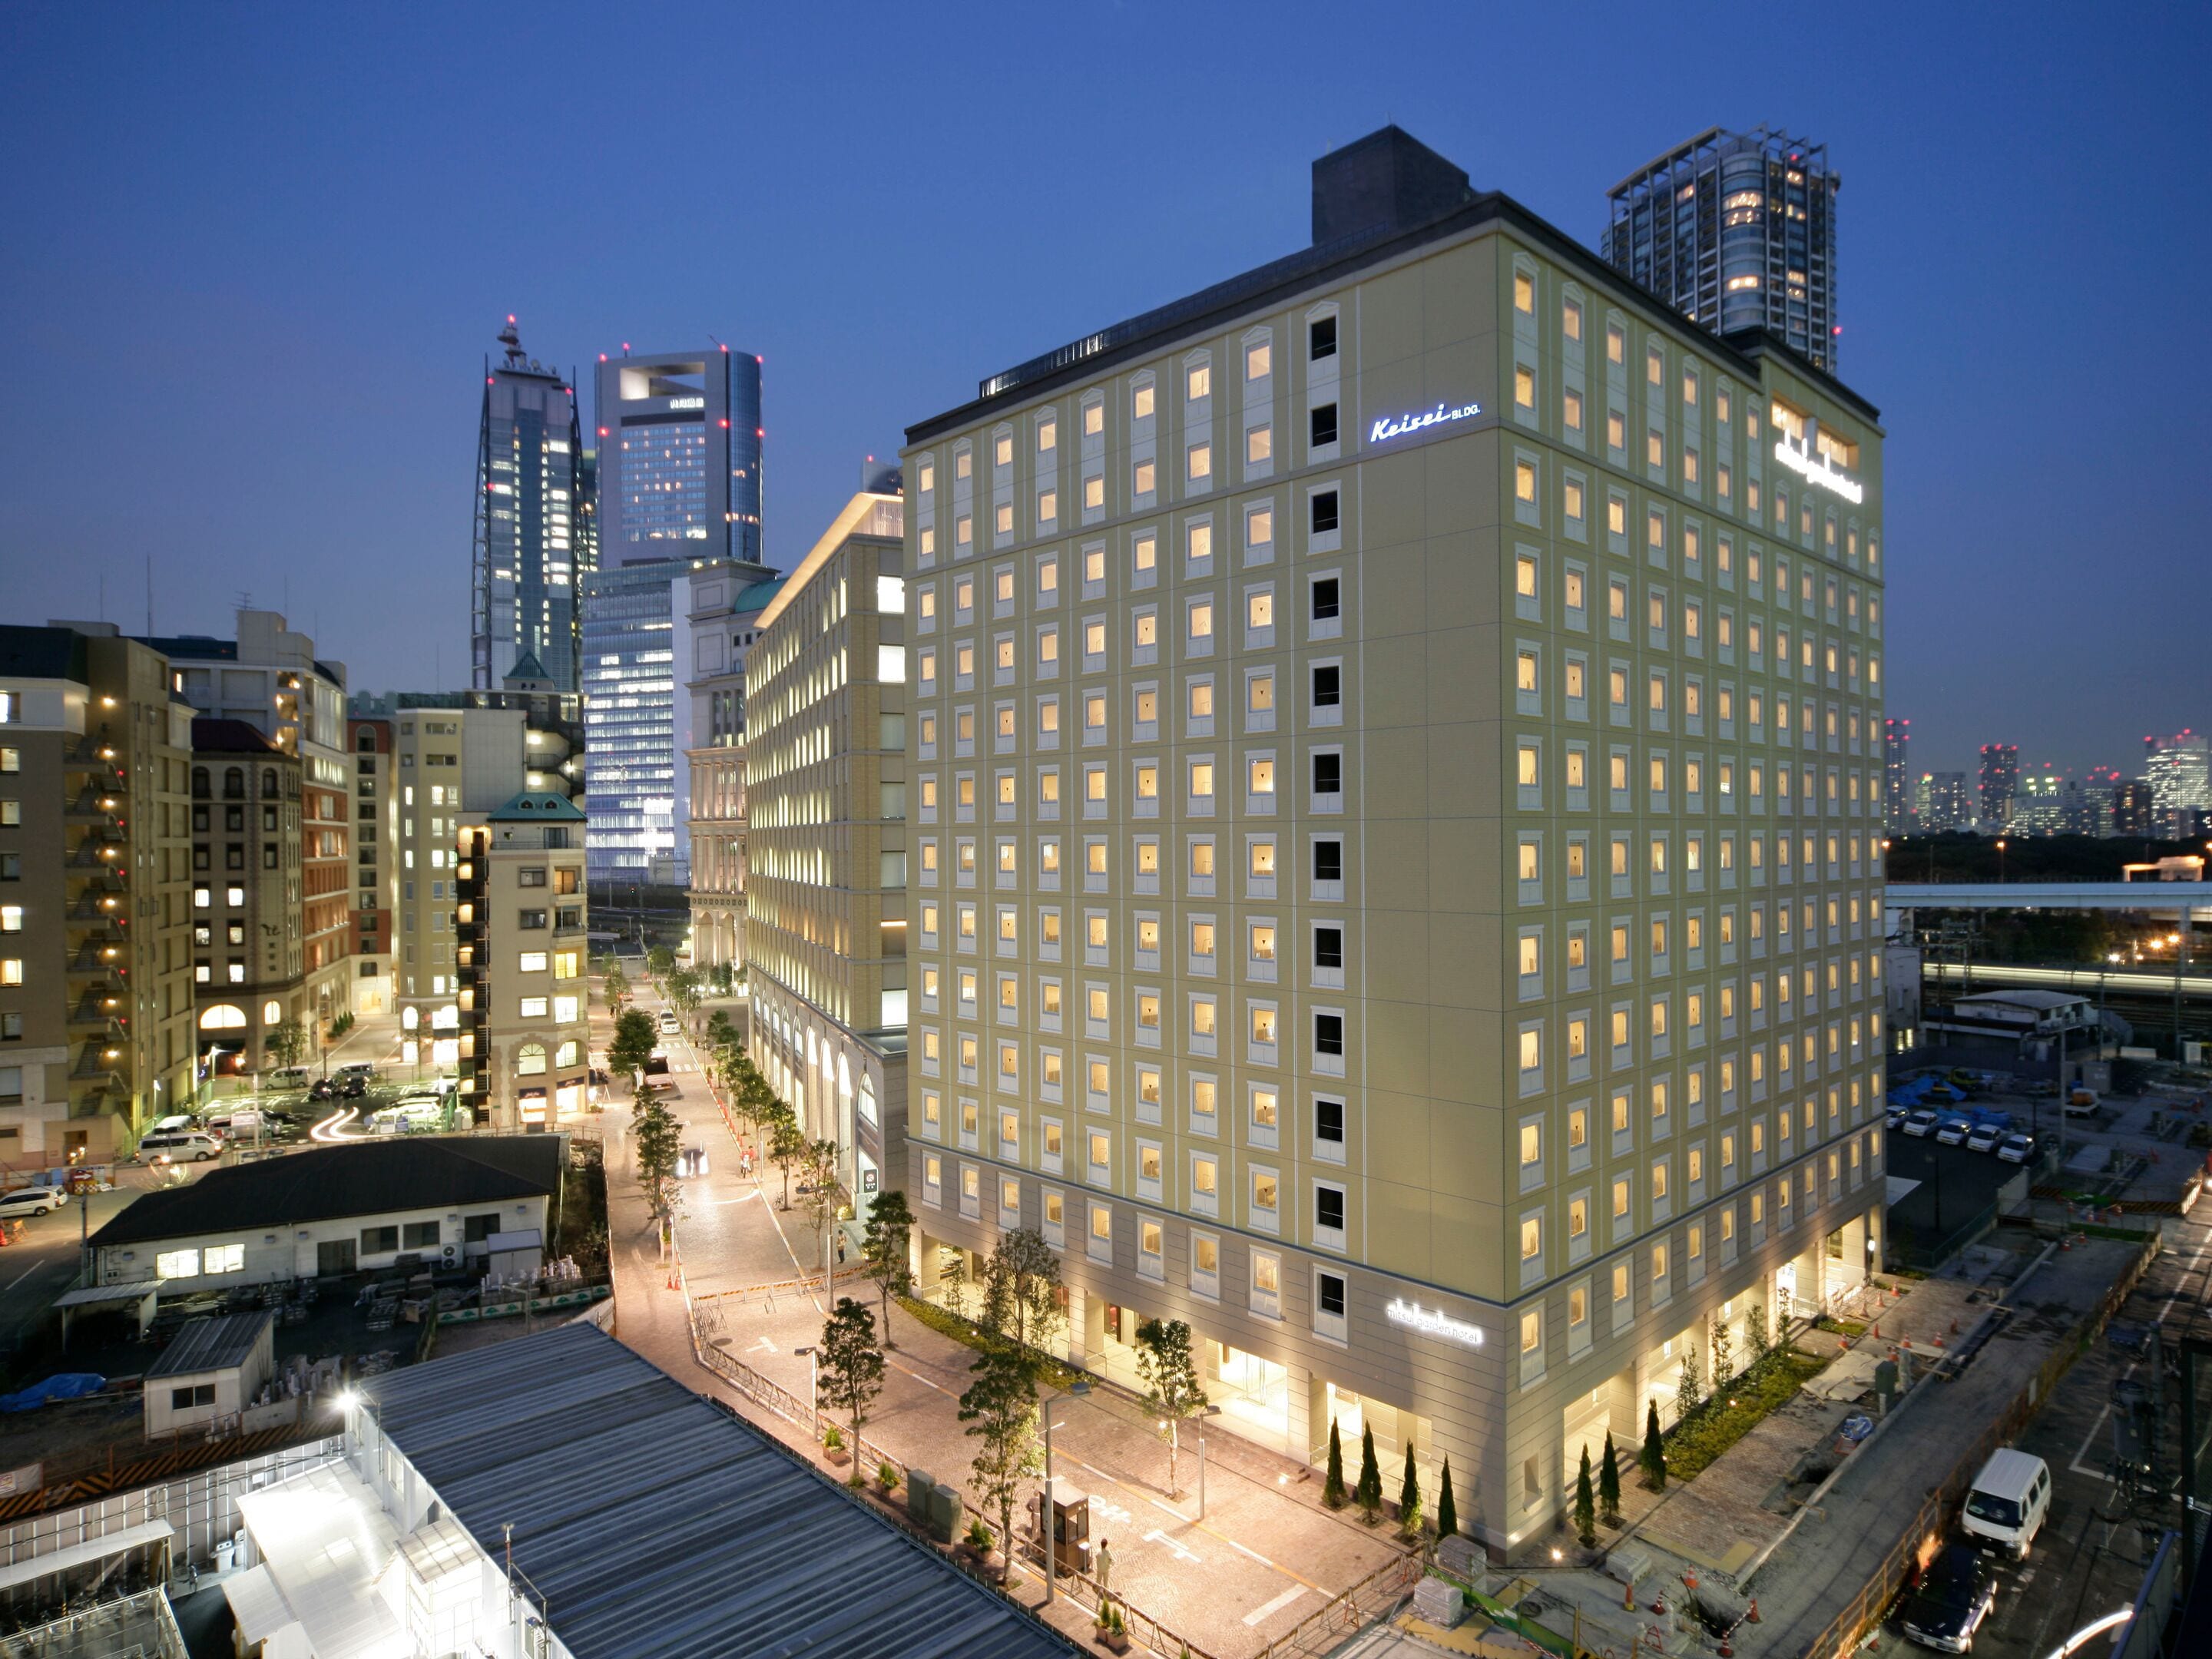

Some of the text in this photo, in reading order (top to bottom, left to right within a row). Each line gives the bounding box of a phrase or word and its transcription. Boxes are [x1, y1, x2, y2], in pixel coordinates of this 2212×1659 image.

[1370, 403, 1481, 442] Keisei BLDG.
[1386, 1301, 1478, 1343] mitsui garden hotel
